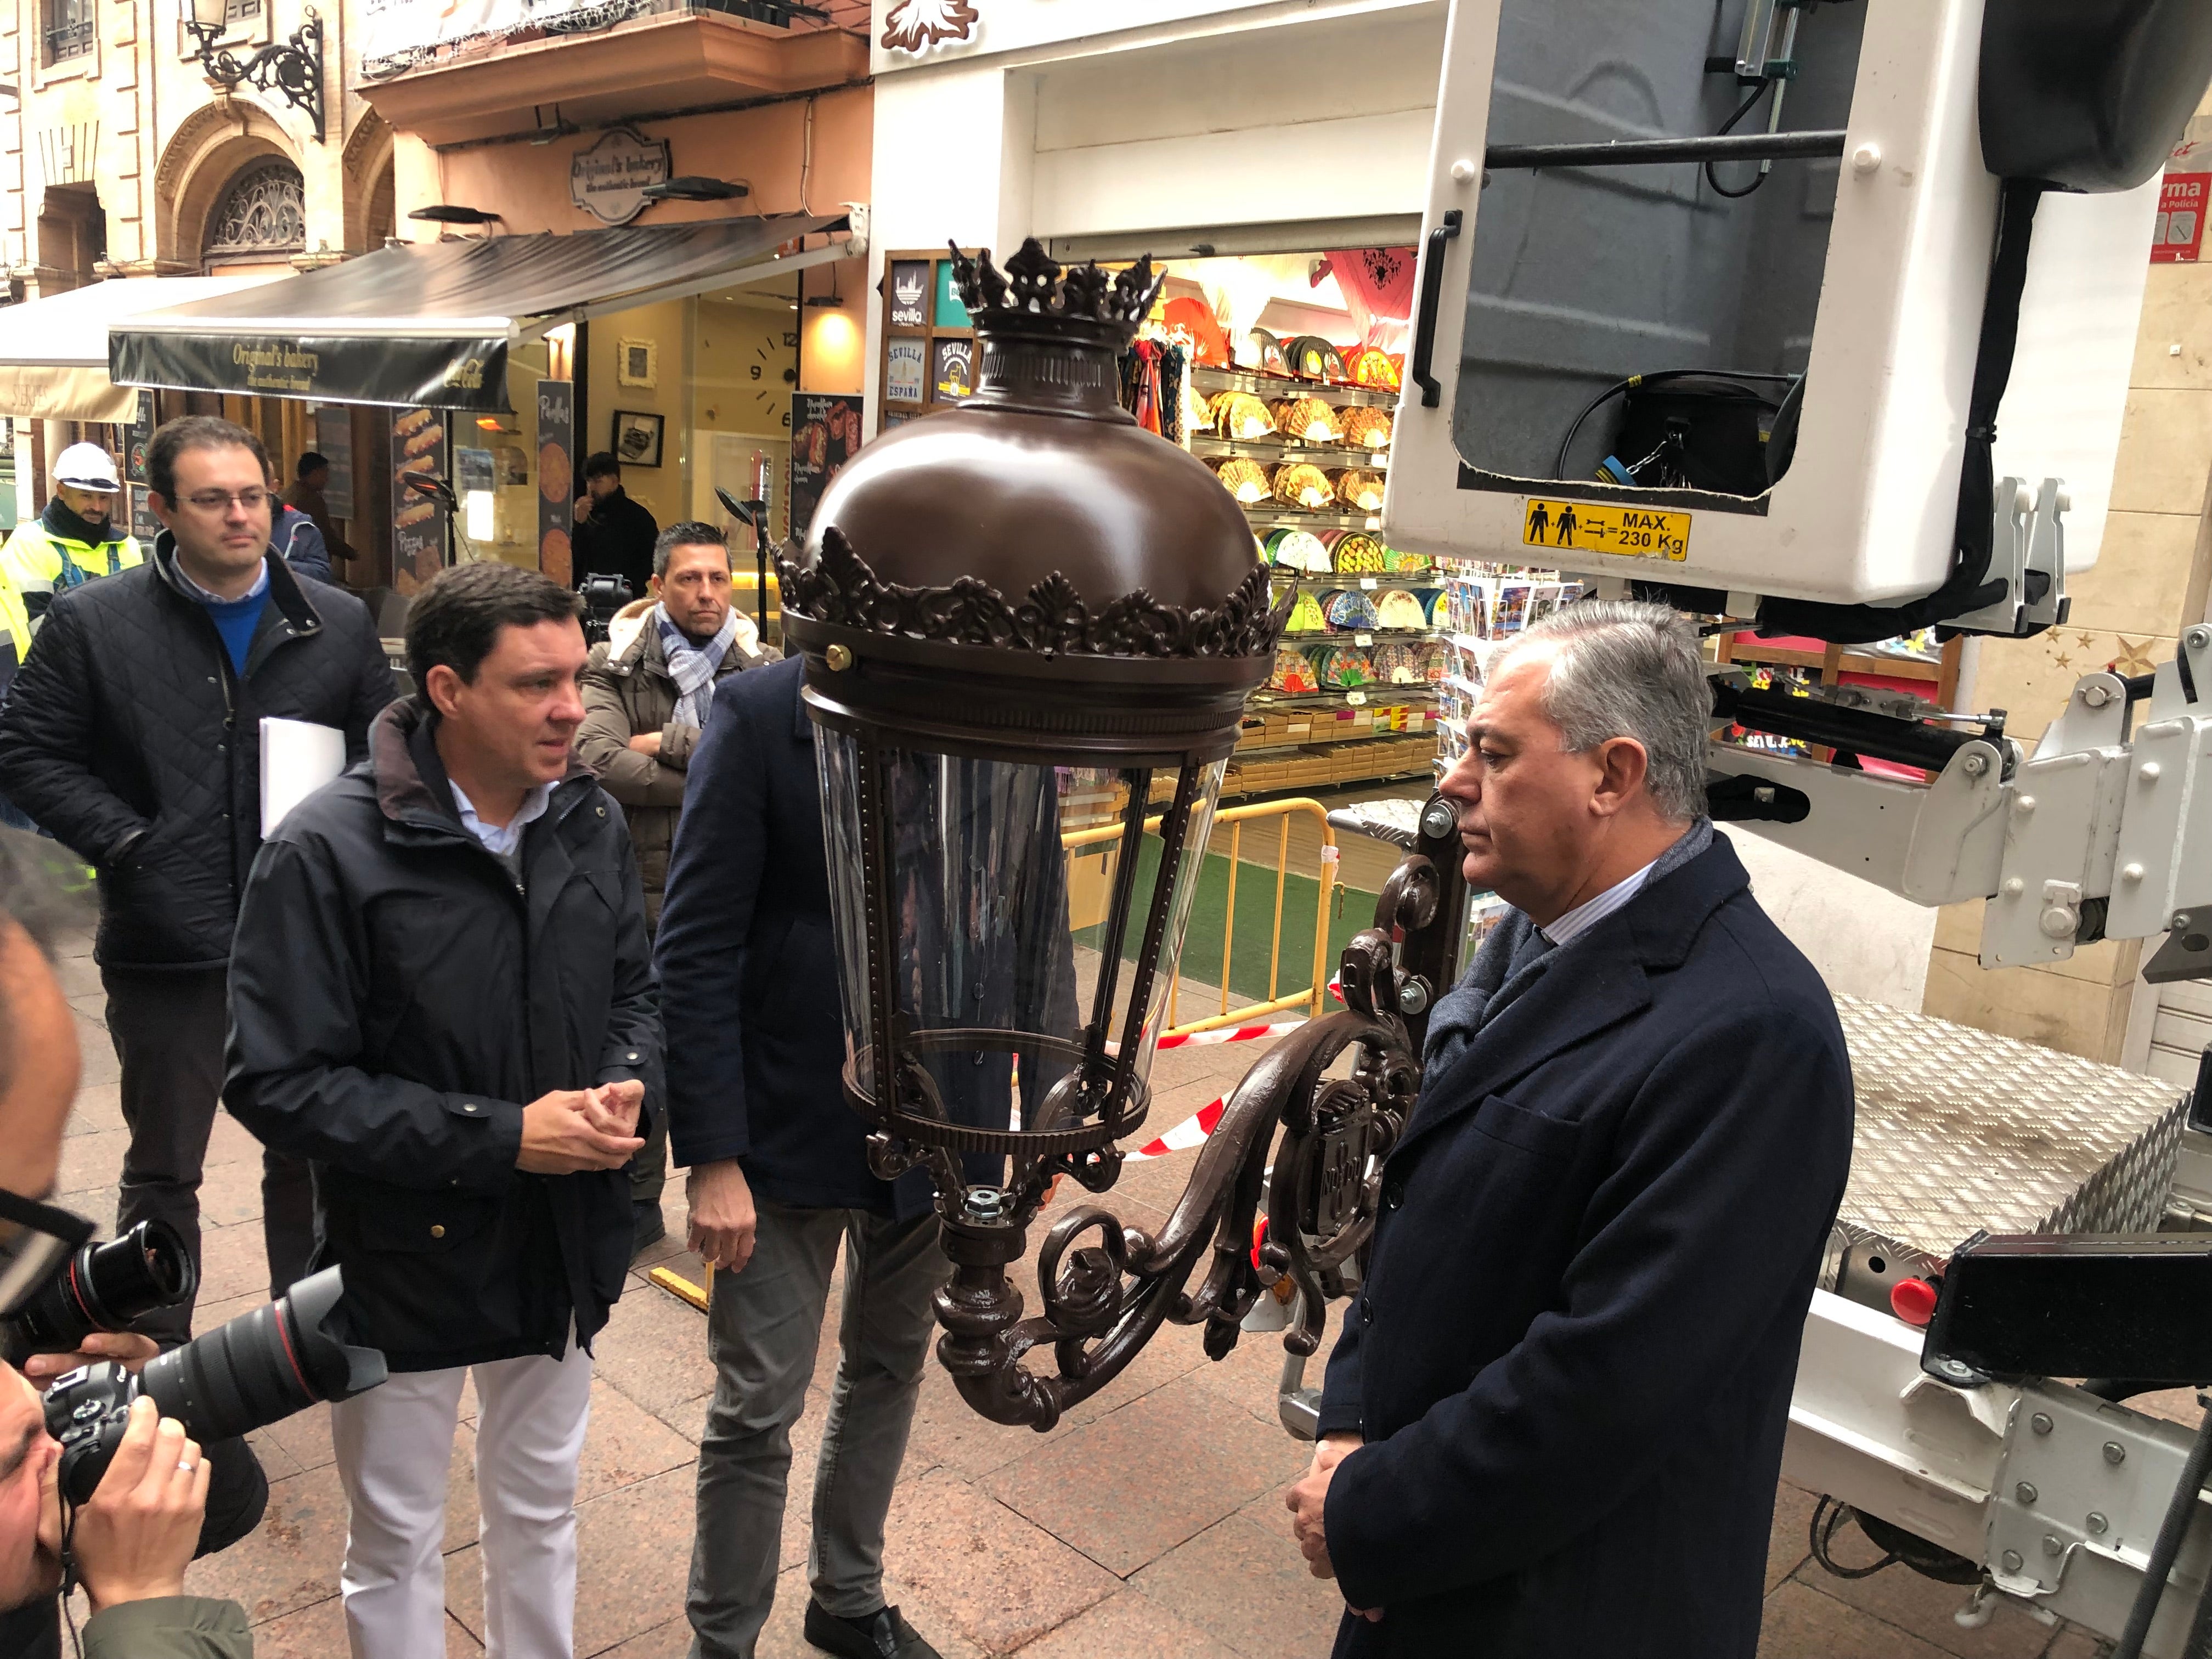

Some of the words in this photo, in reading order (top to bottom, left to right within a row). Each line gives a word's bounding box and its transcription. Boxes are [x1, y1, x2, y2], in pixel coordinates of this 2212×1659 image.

[626, 154, 663, 175] bakery
[892, 307, 922, 322] sevilla
[233, 343, 282, 372] Original's
[284, 345, 318, 376] bakery
[889, 347, 922, 364] SEVILLA
[941, 341, 973, 364] SEVILLA
[751, 366, 761, 380] 9
[889, 385, 918, 398] ESPAÑA
[1622, 512, 1671, 532] MAX.
[1618, 530, 1651, 548] 230
[1657, 534, 1684, 555] Kg
